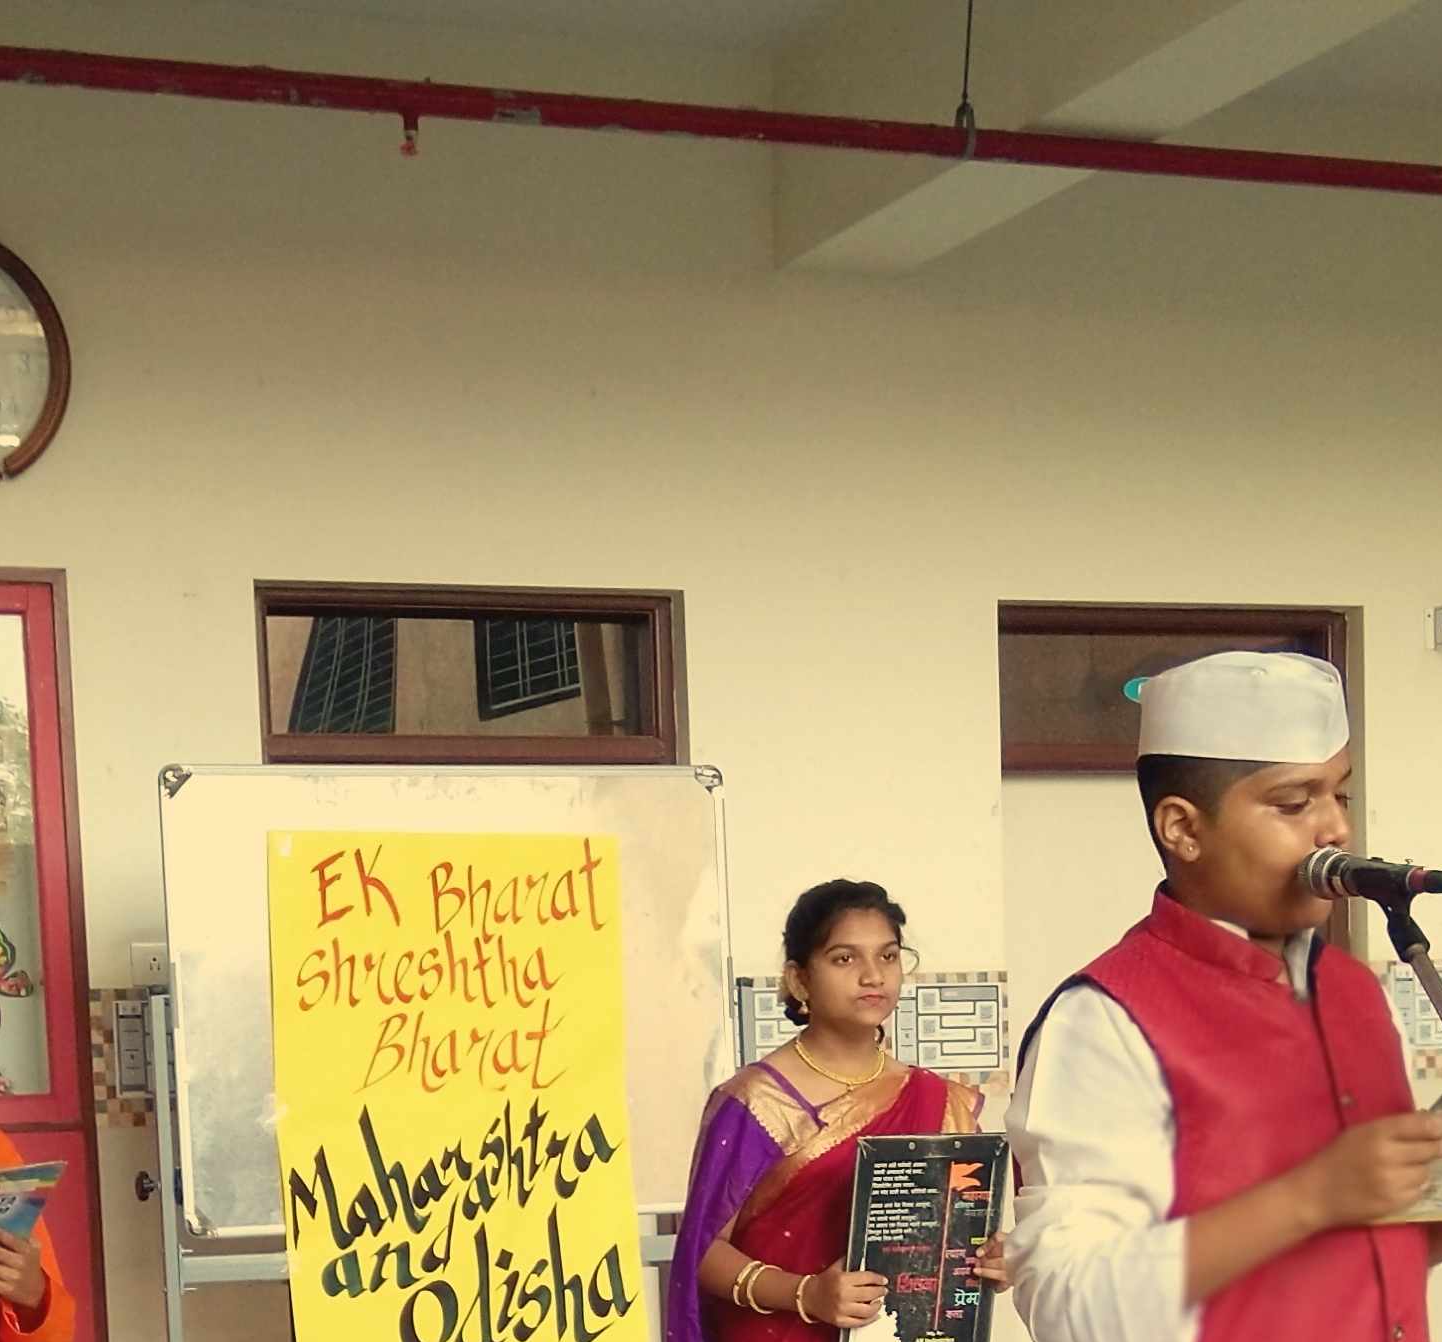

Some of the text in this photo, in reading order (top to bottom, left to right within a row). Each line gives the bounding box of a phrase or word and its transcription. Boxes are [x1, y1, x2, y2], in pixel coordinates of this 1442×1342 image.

[310, 837, 605, 944] EK Bharat
[352, 997, 568, 1094] Bharat
[288, 1095, 623, 1250] Maharashtra
[321, 1193, 458, 1299] and
